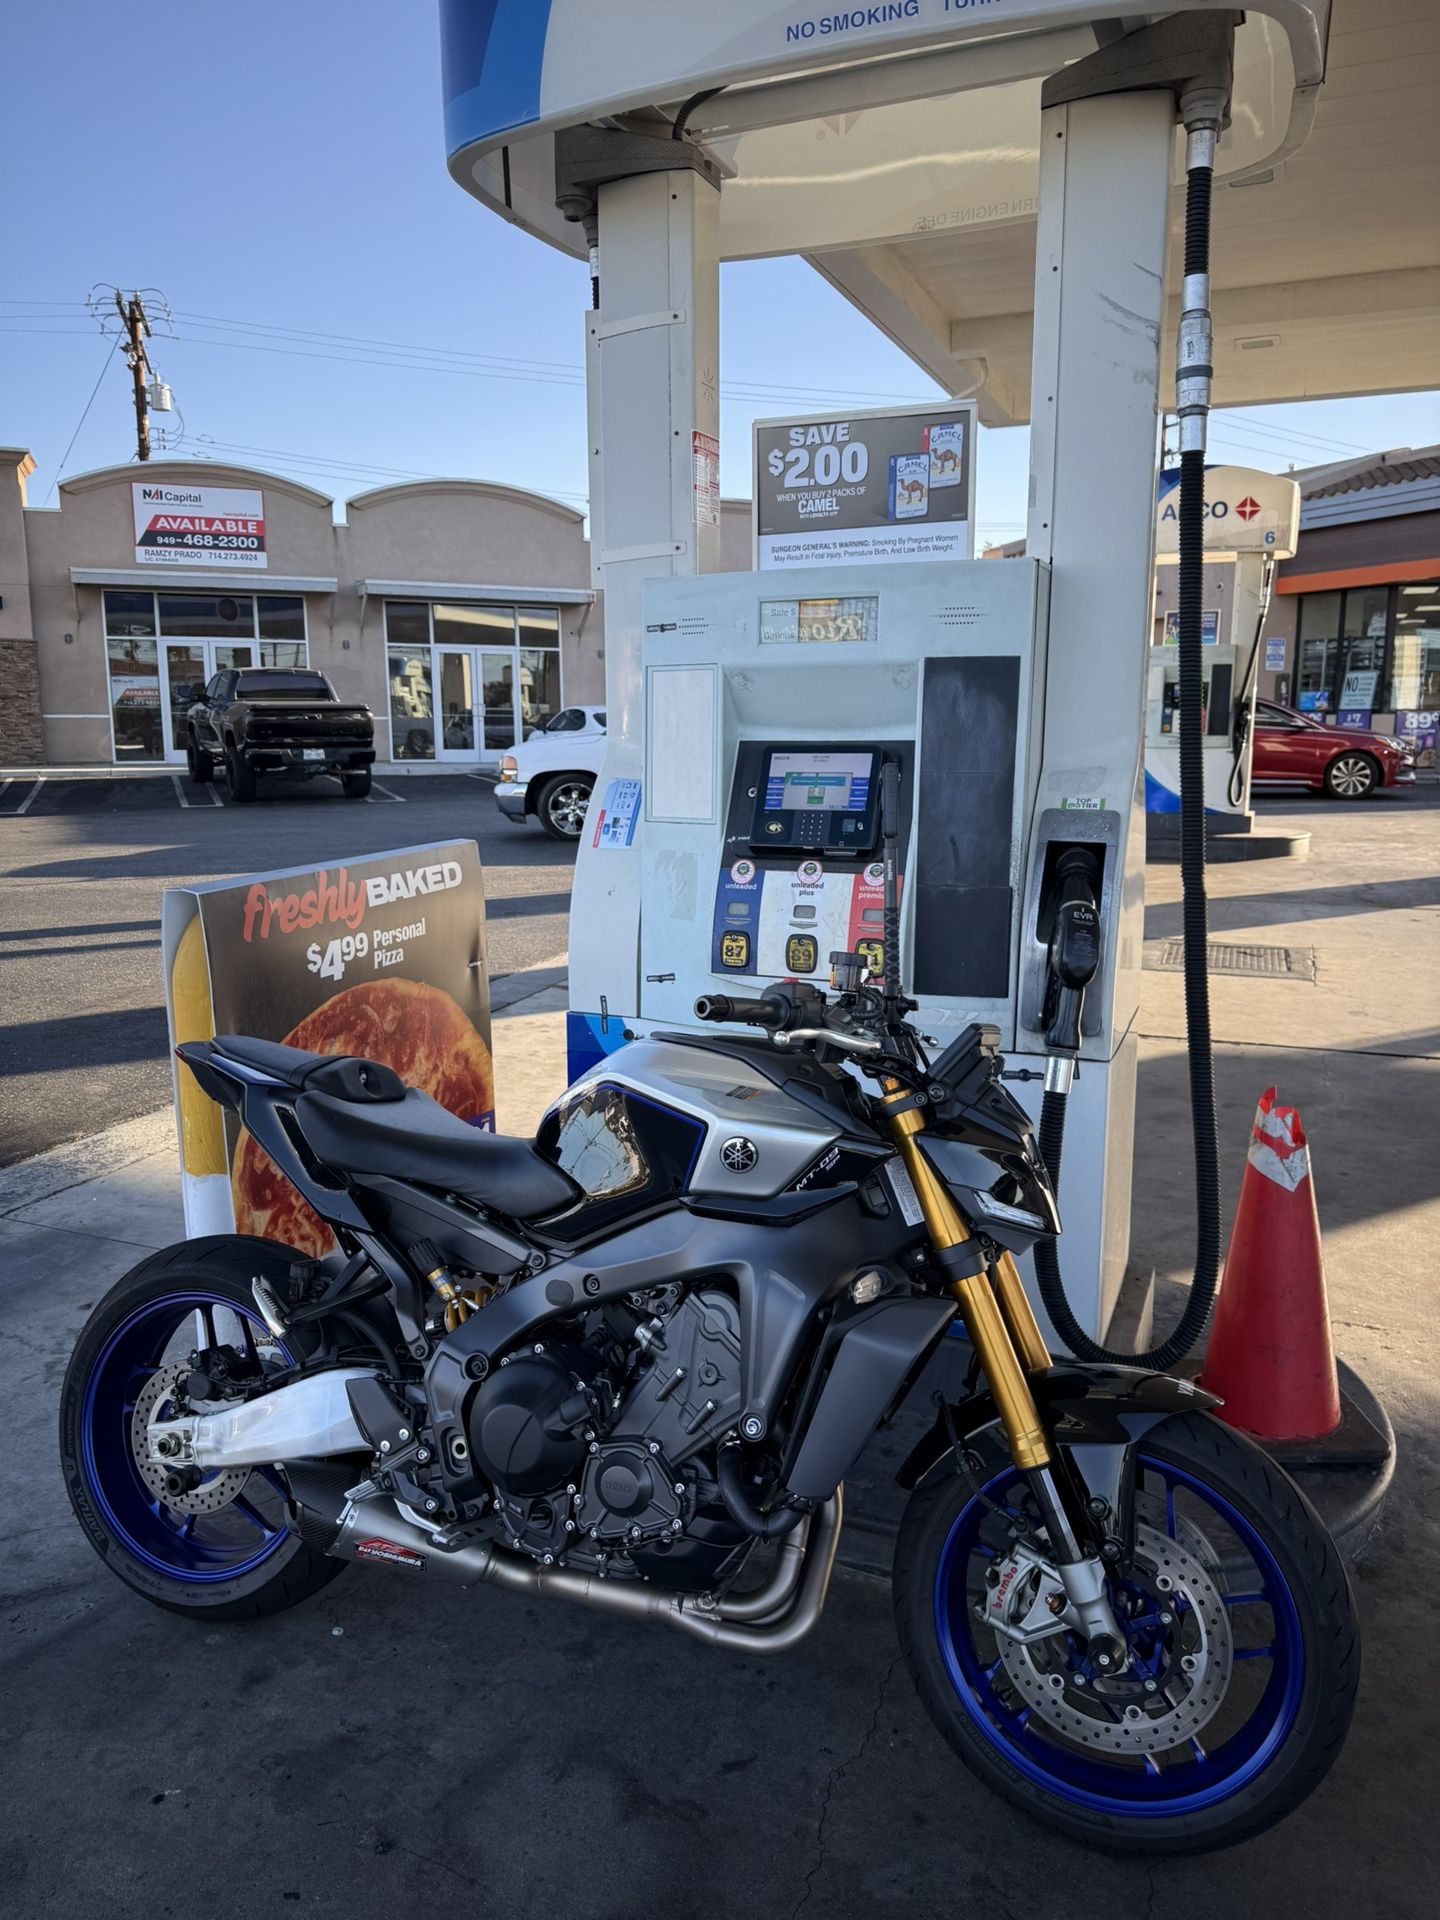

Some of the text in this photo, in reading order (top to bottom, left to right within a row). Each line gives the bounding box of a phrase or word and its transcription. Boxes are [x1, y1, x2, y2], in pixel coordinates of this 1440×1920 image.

[786, 21, 815, 42] NO
[820, 0, 919, 35] SMOKING
[789, 422, 850, 447] SAVE
[931, 430, 962, 443] CAMEL
[768, 442, 868, 488] $2.00
[897, 460, 928, 474] CAMEL
[142, 488, 202, 504] NAI Capital
[776, 494, 796, 502] WHEN
[798, 492, 812, 500] YOU
[812, 491, 826, 499] BUY
[832, 488, 856, 497] PACKS
[856, 486, 867, 495] OF
[798, 498, 840, 513] CAMEL
[1162, 501, 1229, 521] ACO
[156, 517, 257, 533] AVAILABLE
[156, 534, 258, 548] 949-468-2300
[771, 544, 801, 553] SURGEON
[802, 541, 837, 551] GENERAL'S
[838, 539, 871, 548] WARNING:
[872, 538, 897, 547] Smoking
[898, 537, 906, 546] By
[907, 536, 934, 544] Pregnant
[1265, 531, 1276, 544] 6
[144, 549, 172, 558] RAMZY
[174, 550, 202, 559] PRADO
[774, 556, 786, 564] May
[844, 548, 873, 557] Premature
[770, 608, 796, 617] Sale $
[763, 631, 795, 641] Gallons
[1344, 676, 1359, 693] NO
[725, 882, 758, 891] unleaded
[791, 881, 824, 890] unleaded
[799, 889, 815, 897] plus
[242, 861, 463, 943] freshly BAKED
[1073, 911, 1094, 921] EVR
[373, 917, 426, 949] Personal
[373, 947, 404, 970] Pizza
[725, 944, 744, 958] 87
[791, 948, 812, 961] 89
[796, 1146, 839, 1191] MT-09
[826, 1154, 841, 1171] SP
[992, 1566, 1018, 1610] brembo
